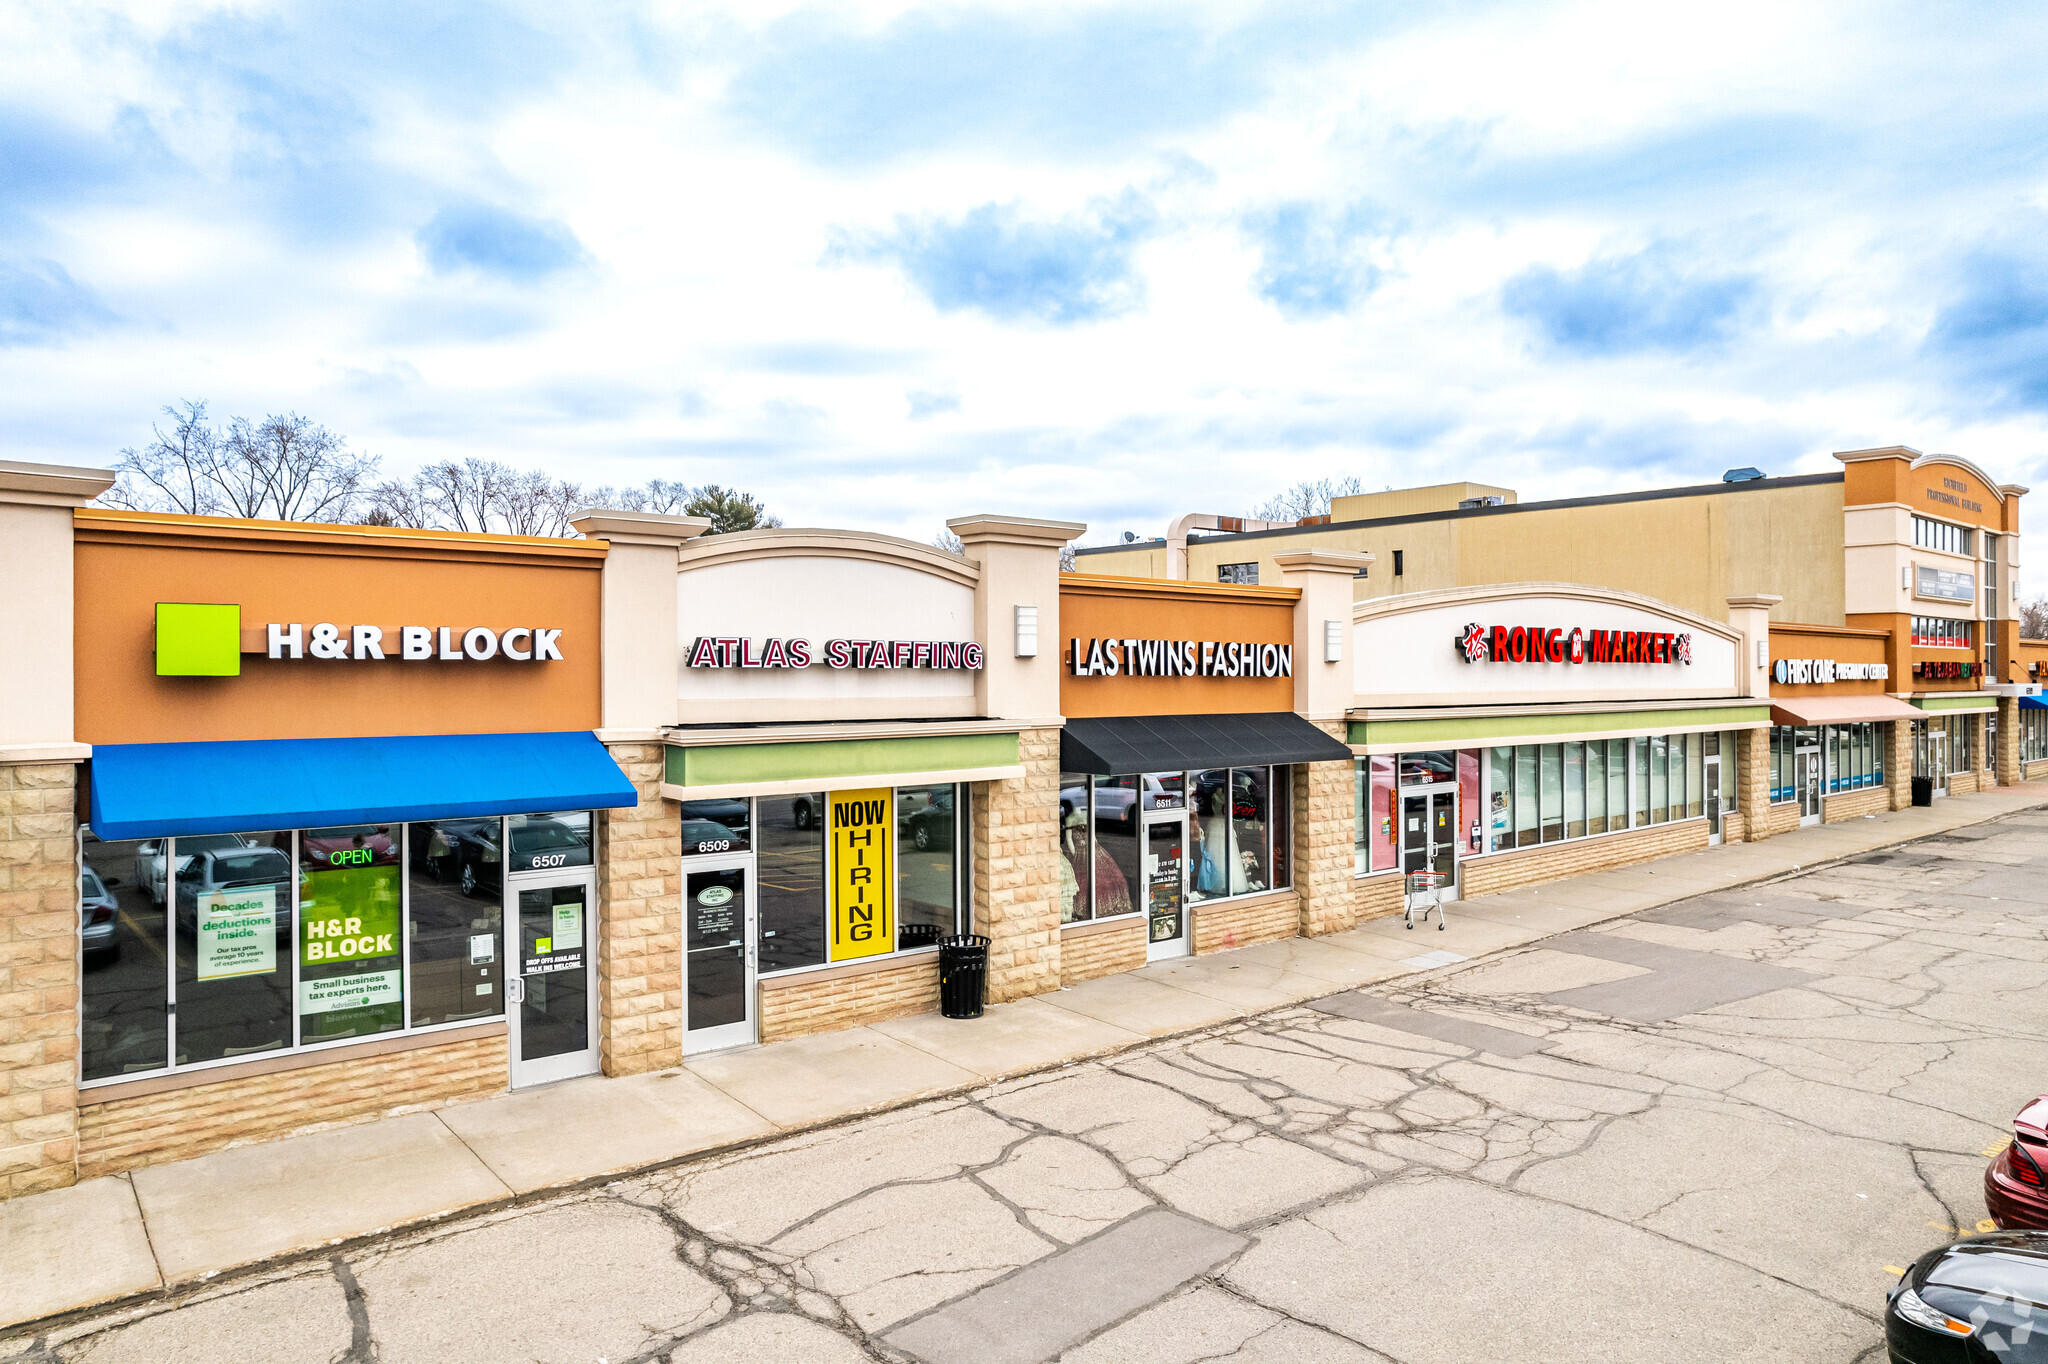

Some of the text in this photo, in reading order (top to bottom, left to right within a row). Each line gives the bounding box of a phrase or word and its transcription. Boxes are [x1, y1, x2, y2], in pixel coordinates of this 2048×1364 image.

[265, 622, 565, 661] H&R BLOCK
[1490, 625, 1563, 664] RONG
[1589, 629, 1675, 664] MARKET
[687, 636, 983, 671] ATLAS STAFFING
[1071, 637, 1293, 678] LAS TWINS FASHION
[1787, 659, 1812, 684] FIRST
[1813, 659, 1835, 684] CARE
[1156, 799, 1171, 808] 6511
[834, 800, 885, 828] NOW
[698, 839, 730, 853] 6509
[330, 849, 373, 866] OPEN
[532, 854, 567, 868] 6507
[849, 829, 873, 942] HIRING
[211, 901, 264, 912] Decades
[203, 917, 271, 931] deductions
[307, 917, 361, 939] H&R
[217, 928, 257, 940] inside.
[307, 933, 393, 961] BLOCK
[210, 953, 237, 962] average
[246, 950, 264, 958] years
[554, 954, 581, 962] AVAILABLE
[526, 965, 543, 973] WALK
[554, 961, 581, 970] WELCOME
[313, 974, 385, 990] Small business
[309, 983, 391, 1000] tax experts here.
[326, 1008, 385, 1023] bienvenidos
